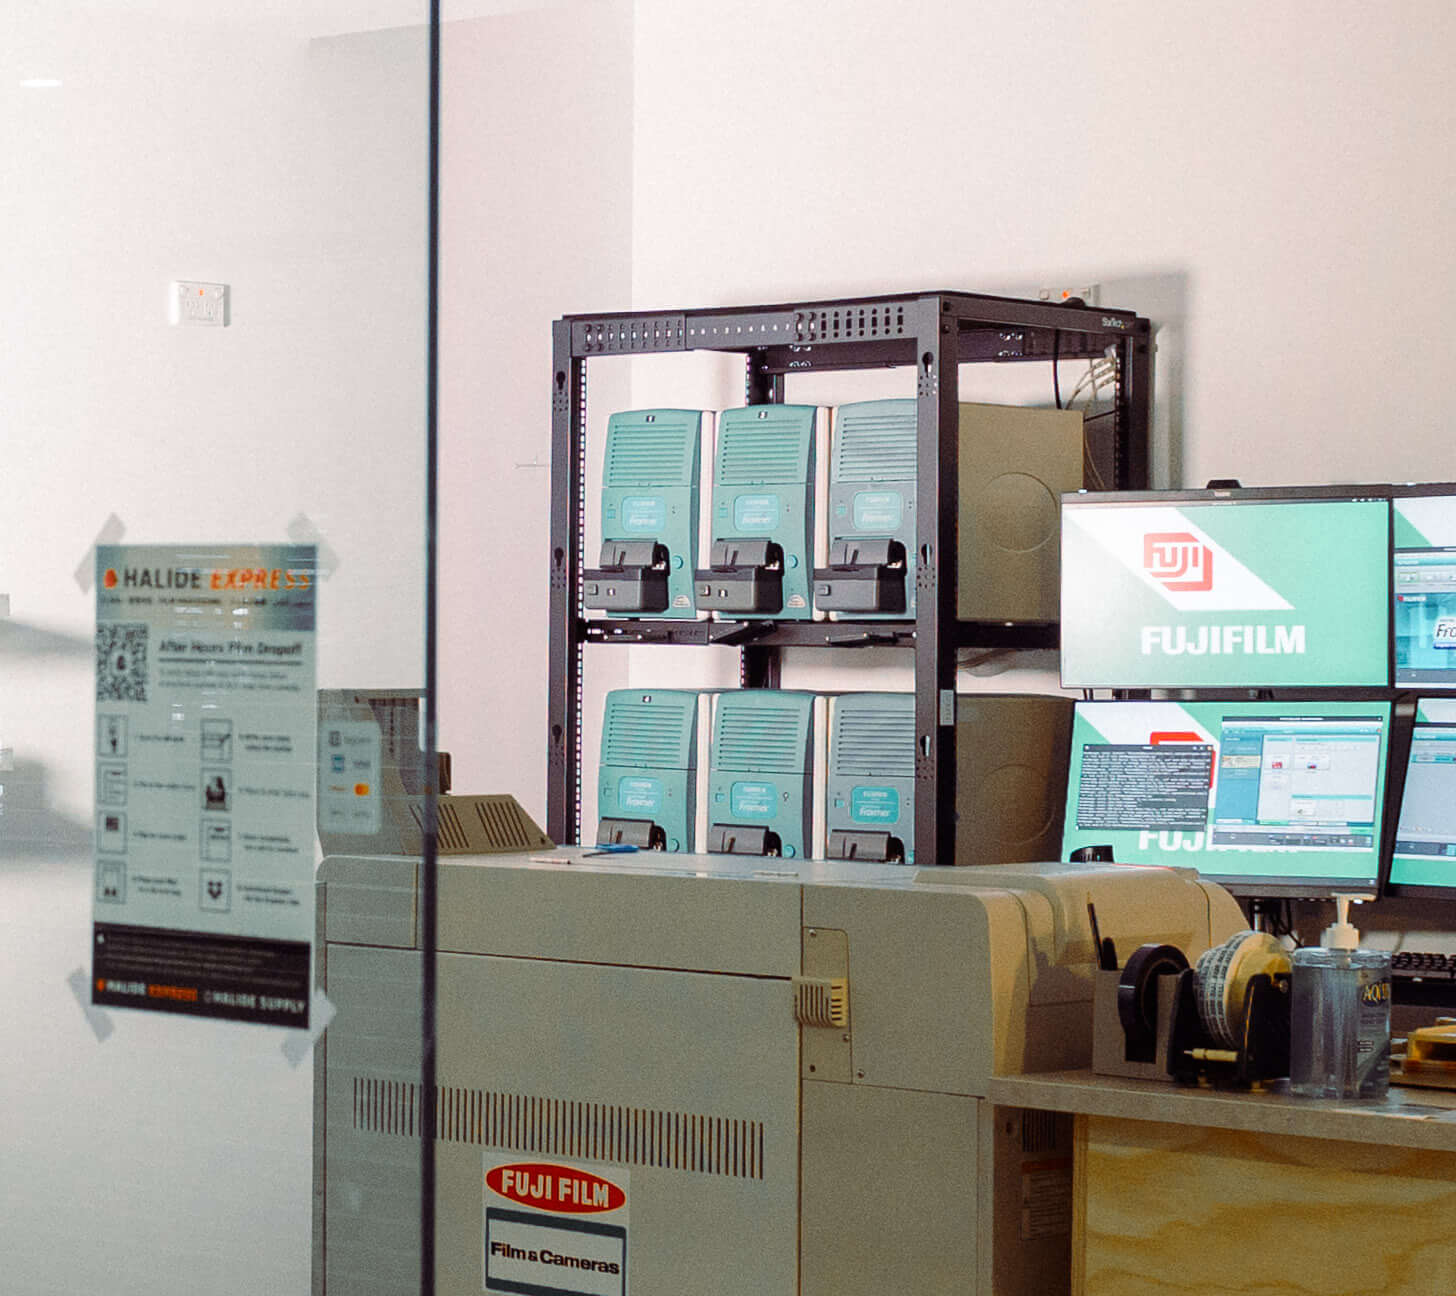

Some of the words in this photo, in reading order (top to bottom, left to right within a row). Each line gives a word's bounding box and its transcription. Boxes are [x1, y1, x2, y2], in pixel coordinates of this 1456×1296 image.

[123, 567, 202, 590] HALIDE
[209, 567, 310, 591] EXPRESS
[1141, 624, 1306, 655] FUJIFILM
[501, 1168, 553, 1200] FUJI
[558, 1176, 610, 1209] FILM
[490, 1241, 526, 1261] Film
[539, 1249, 621, 1275] Cameras
